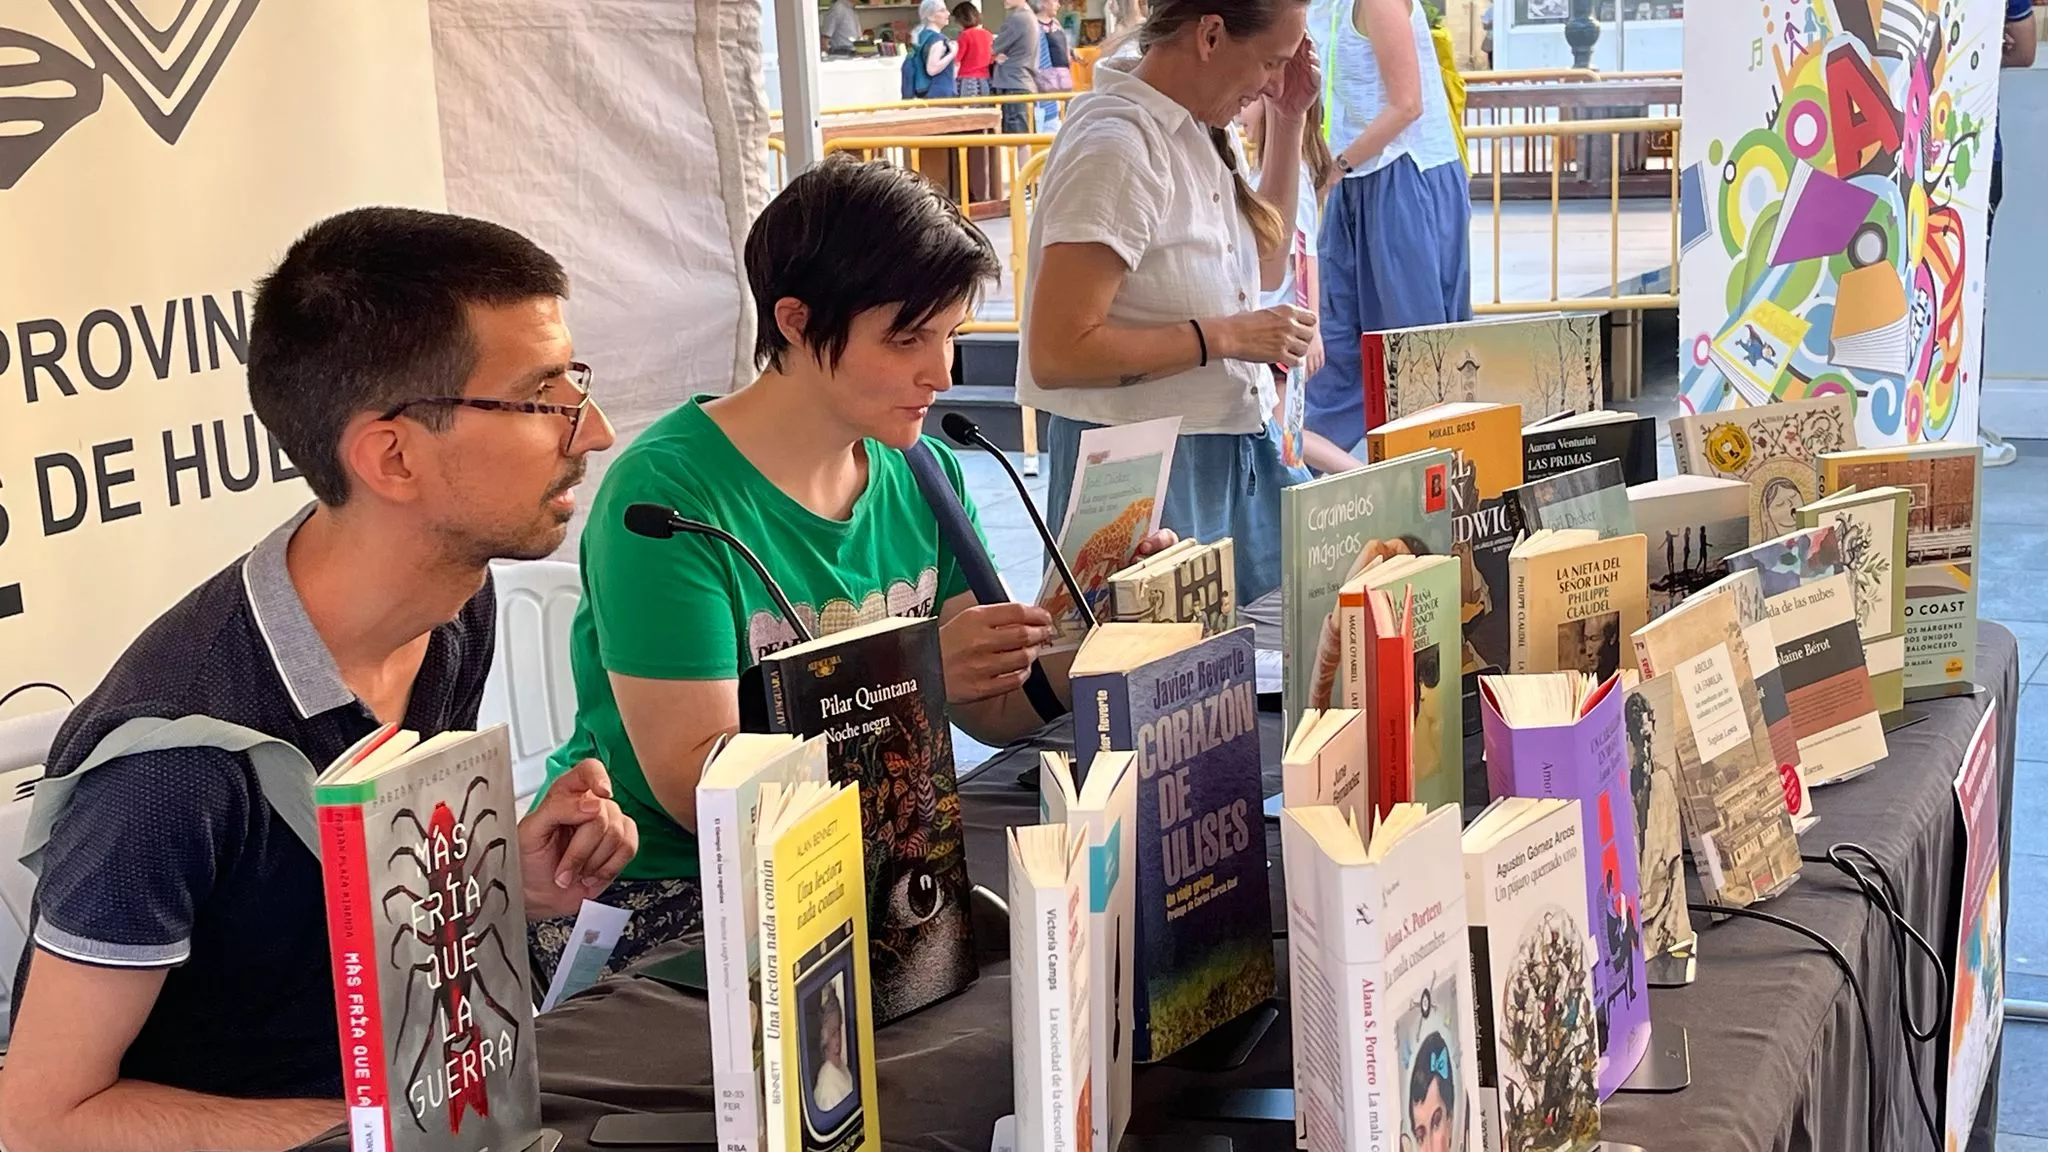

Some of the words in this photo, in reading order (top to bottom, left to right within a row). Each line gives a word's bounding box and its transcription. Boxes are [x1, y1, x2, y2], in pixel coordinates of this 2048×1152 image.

[1428, 425, 1455, 440] MIKAEL
[1457, 421, 1476, 433] ROSS
[1527, 441, 1556, 453] Aurora
[1558, 435, 1597, 449] Venturini
[1527, 458, 1548, 471] LAS
[1550, 452, 1592, 468] PRIMAS
[34, 438, 142, 536] DE
[1307, 494, 1374, 531] Caramelos
[1308, 532, 1361, 571] mágicos
[1557, 568, 1569, 581] LA
[1571, 561, 1600, 576] NIETA
[1603, 557, 1621, 571] DEL
[1560, 577, 1591, 594] SEÑOR
[1594, 571, 1618, 586] LINH
[1566, 600, 1610, 619] CLAUDEL
[1568, 586, 1609, 605] PHILIPPE
[1781, 600, 1793, 613] de
[1793, 597, 1807, 609] las
[1808, 588, 1836, 604] nubes
[1920, 601, 1965, 615] COAST
[1920, 622, 1962, 632] MÁRGENES
[1922, 633, 1953, 642] UNIDOS
[1906, 641, 1958, 652] BALONCESTO
[1153, 670, 1193, 709] Javier
[1198, 648, 1245, 689] Reverte
[820, 693, 852, 718] Pilar
[855, 678, 918, 710] Quintana
[1096, 690, 1110, 731] Reverte
[823, 720, 860, 744] Noche
[862, 715, 891, 737] negra
[1138, 679, 1255, 780] CORAZÓN
[1158, 766, 1192, 830] DE
[415, 823, 468, 877] MÁS
[1161, 798, 1250, 887] ULISES
[1554, 825, 1575, 845] Arcos
[760, 859, 775, 910] común
[411, 873, 481, 939] FRÍA
[1412, 901, 1442, 933] Portero
[763, 915, 776, 949] nada
[1046, 908, 1058, 951] Victoria
[345, 952, 363, 987] MÁS
[425, 932, 478, 990] QUE
[1048, 953, 1059, 991] Camps
[765, 955, 779, 1006] lectora
[1362, 978, 1375, 1017] Alana
[348, 994, 369, 1039] FRÍA
[440, 995, 473, 1042] LA
[767, 1011, 780, 1039] Una
[1050, 1008, 1061, 1020] La
[1364, 1020, 1377, 1032] S.
[353, 1045, 371, 1079] QUE
[1050, 1022, 1062, 1072] sociedad
[1365, 1036, 1378, 1085] Portero
[409, 1030, 513, 1119] GUERRA
[771, 1061, 782, 1105] BENNETT
[1052, 1074, 1063, 1087] de
[356, 1086, 373, 1106] LA
[723, 1103, 740, 1111] FER
[1052, 1089, 1063, 1099] la
[1368, 1092, 1380, 1107] La
[1369, 1110, 1383, 1141] mala
[727, 1144, 747, 1152] RBA
